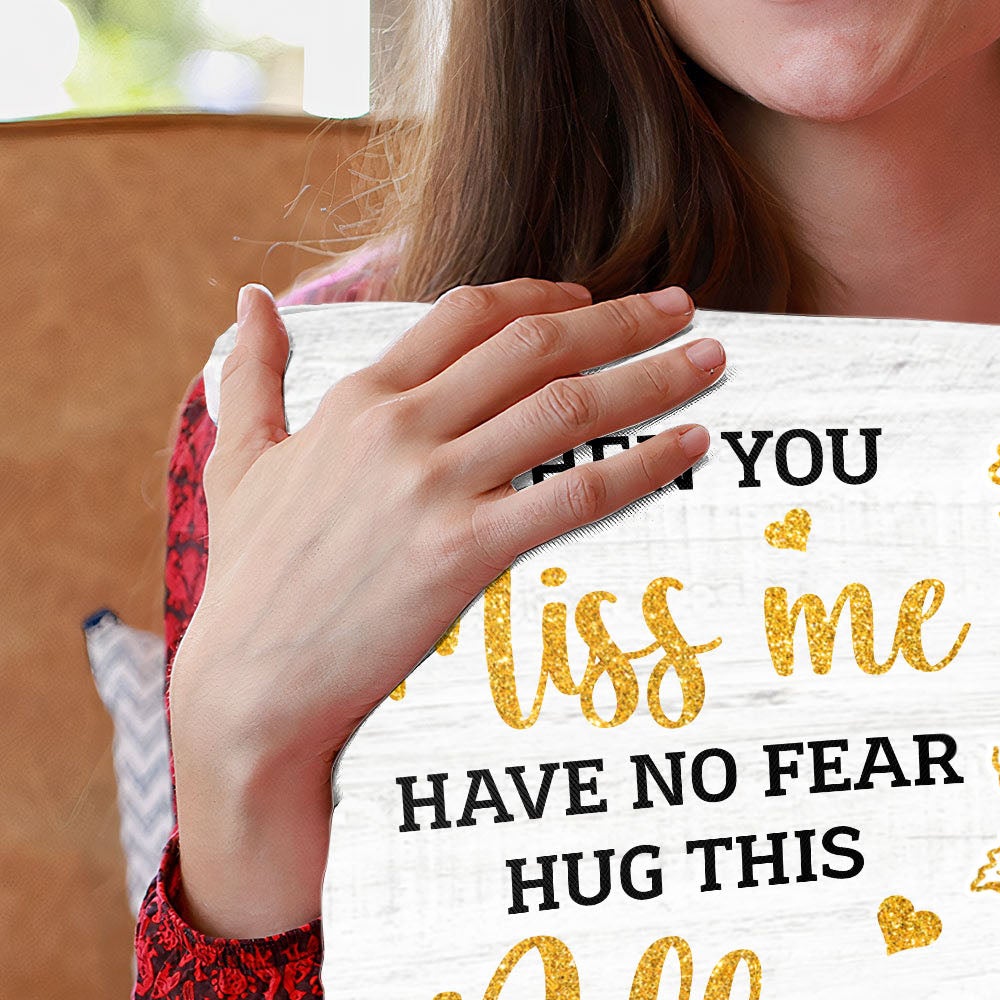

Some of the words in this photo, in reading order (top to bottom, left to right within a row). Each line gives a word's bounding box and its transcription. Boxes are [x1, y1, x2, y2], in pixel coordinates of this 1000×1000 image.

[721, 428, 882, 488] YOU
[386, 566, 723, 731] iss
[763, 578, 972, 677] me
[396, 758, 608, 833] HAVE
[630, 747, 737, 810] NO
[763, 733, 964, 798] FEAR
[506, 844, 663, 915] HUG
[686, 825, 865, 893] THIS
